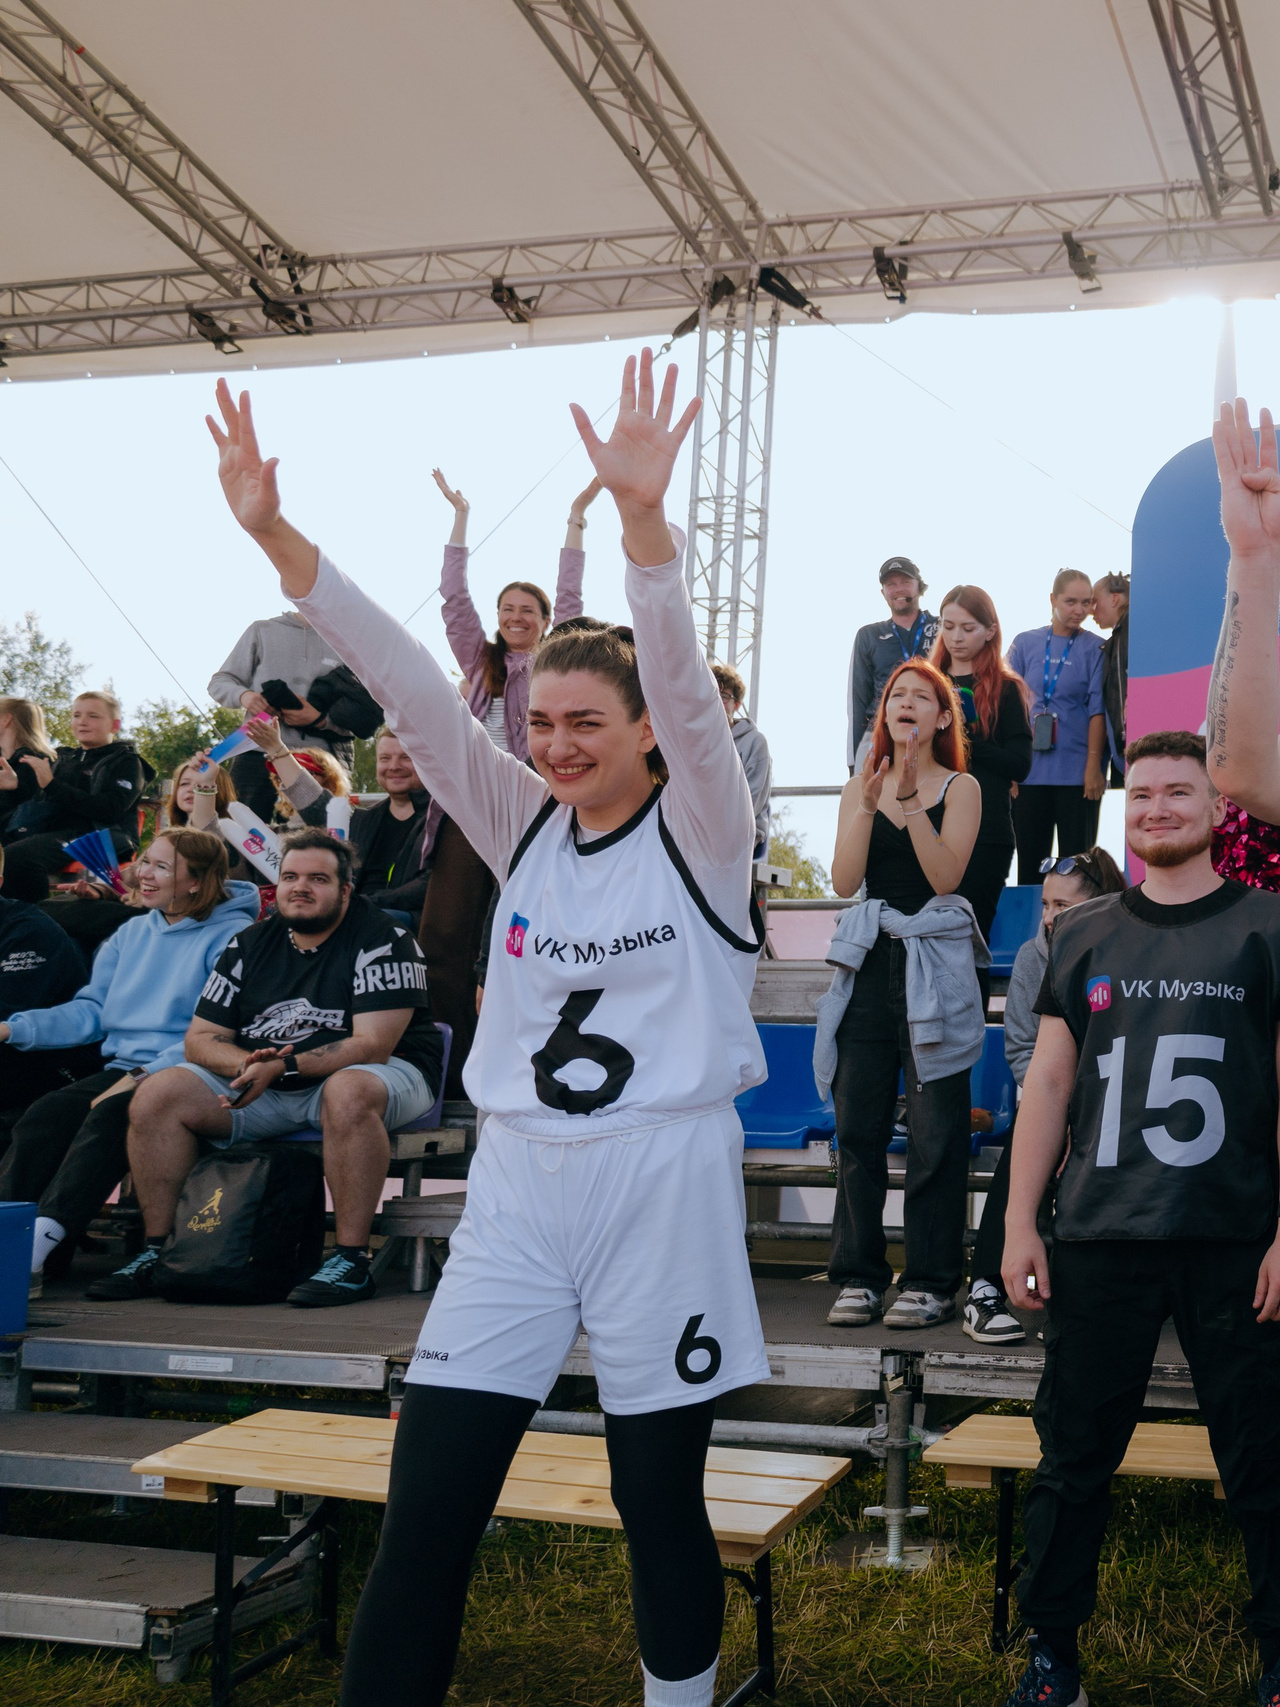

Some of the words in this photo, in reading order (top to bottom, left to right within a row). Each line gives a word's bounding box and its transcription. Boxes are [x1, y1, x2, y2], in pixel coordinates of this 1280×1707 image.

[534, 934, 568, 963] VK
[573, 924, 677, 965] Музыка
[1120, 980, 1153, 998] VK
[1158, 979, 1246, 1003] Музыка
[531, 987, 635, 1117] 6
[1095, 1033, 1226, 1167] 15
[674, 1312, 722, 1385] 6
